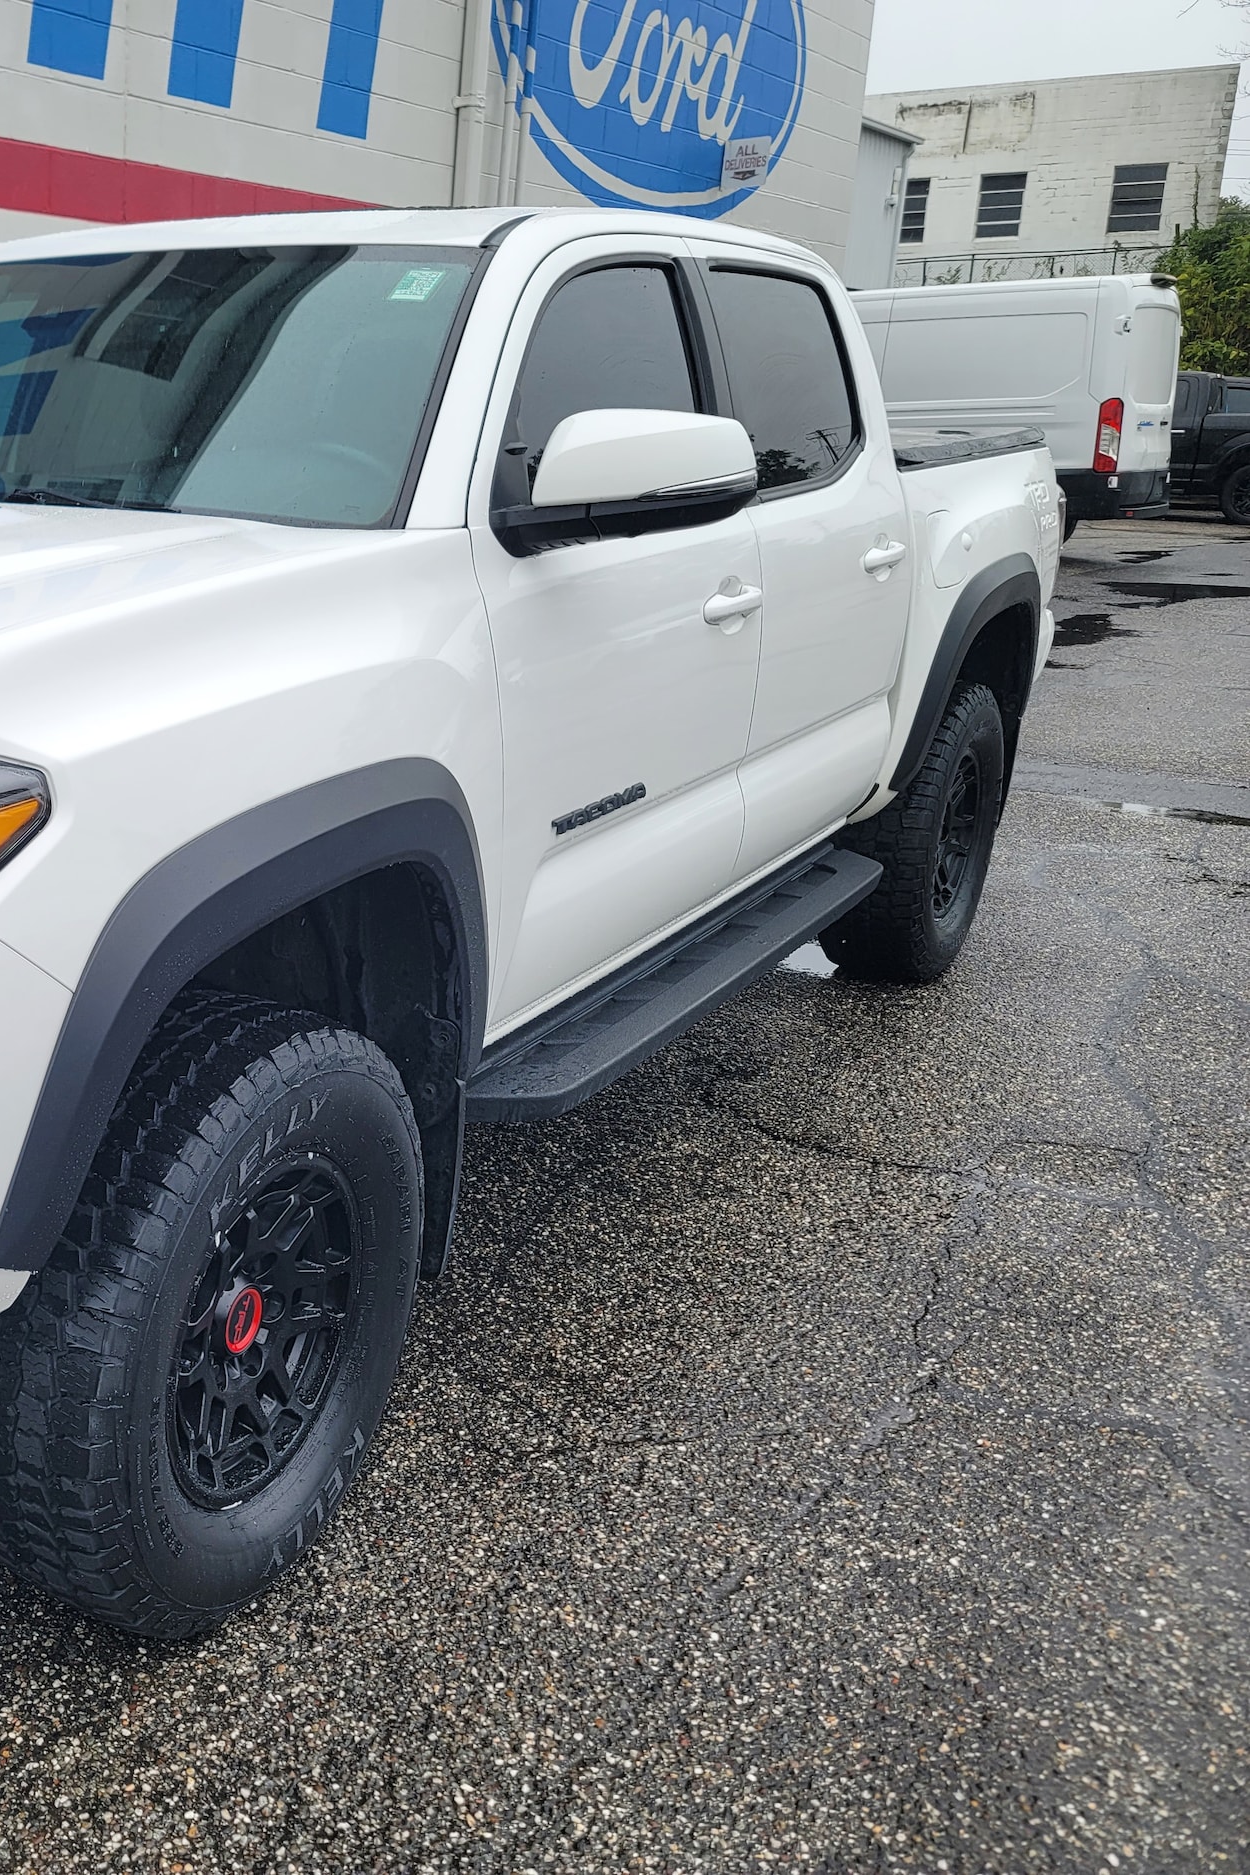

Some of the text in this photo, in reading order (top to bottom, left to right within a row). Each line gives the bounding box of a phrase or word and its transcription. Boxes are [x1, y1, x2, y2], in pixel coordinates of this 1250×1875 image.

[569, 0, 757, 146] Ford
[725, 156, 767, 171] DELIVERIES
[736, 144, 759, 157] ALL
[1023, 480, 1050, 511] TRD
[1040, 511, 1058, 532] PRO
[551, 781, 647, 835] TACOMA
[260, 1420, 365, 1579] KELLY
